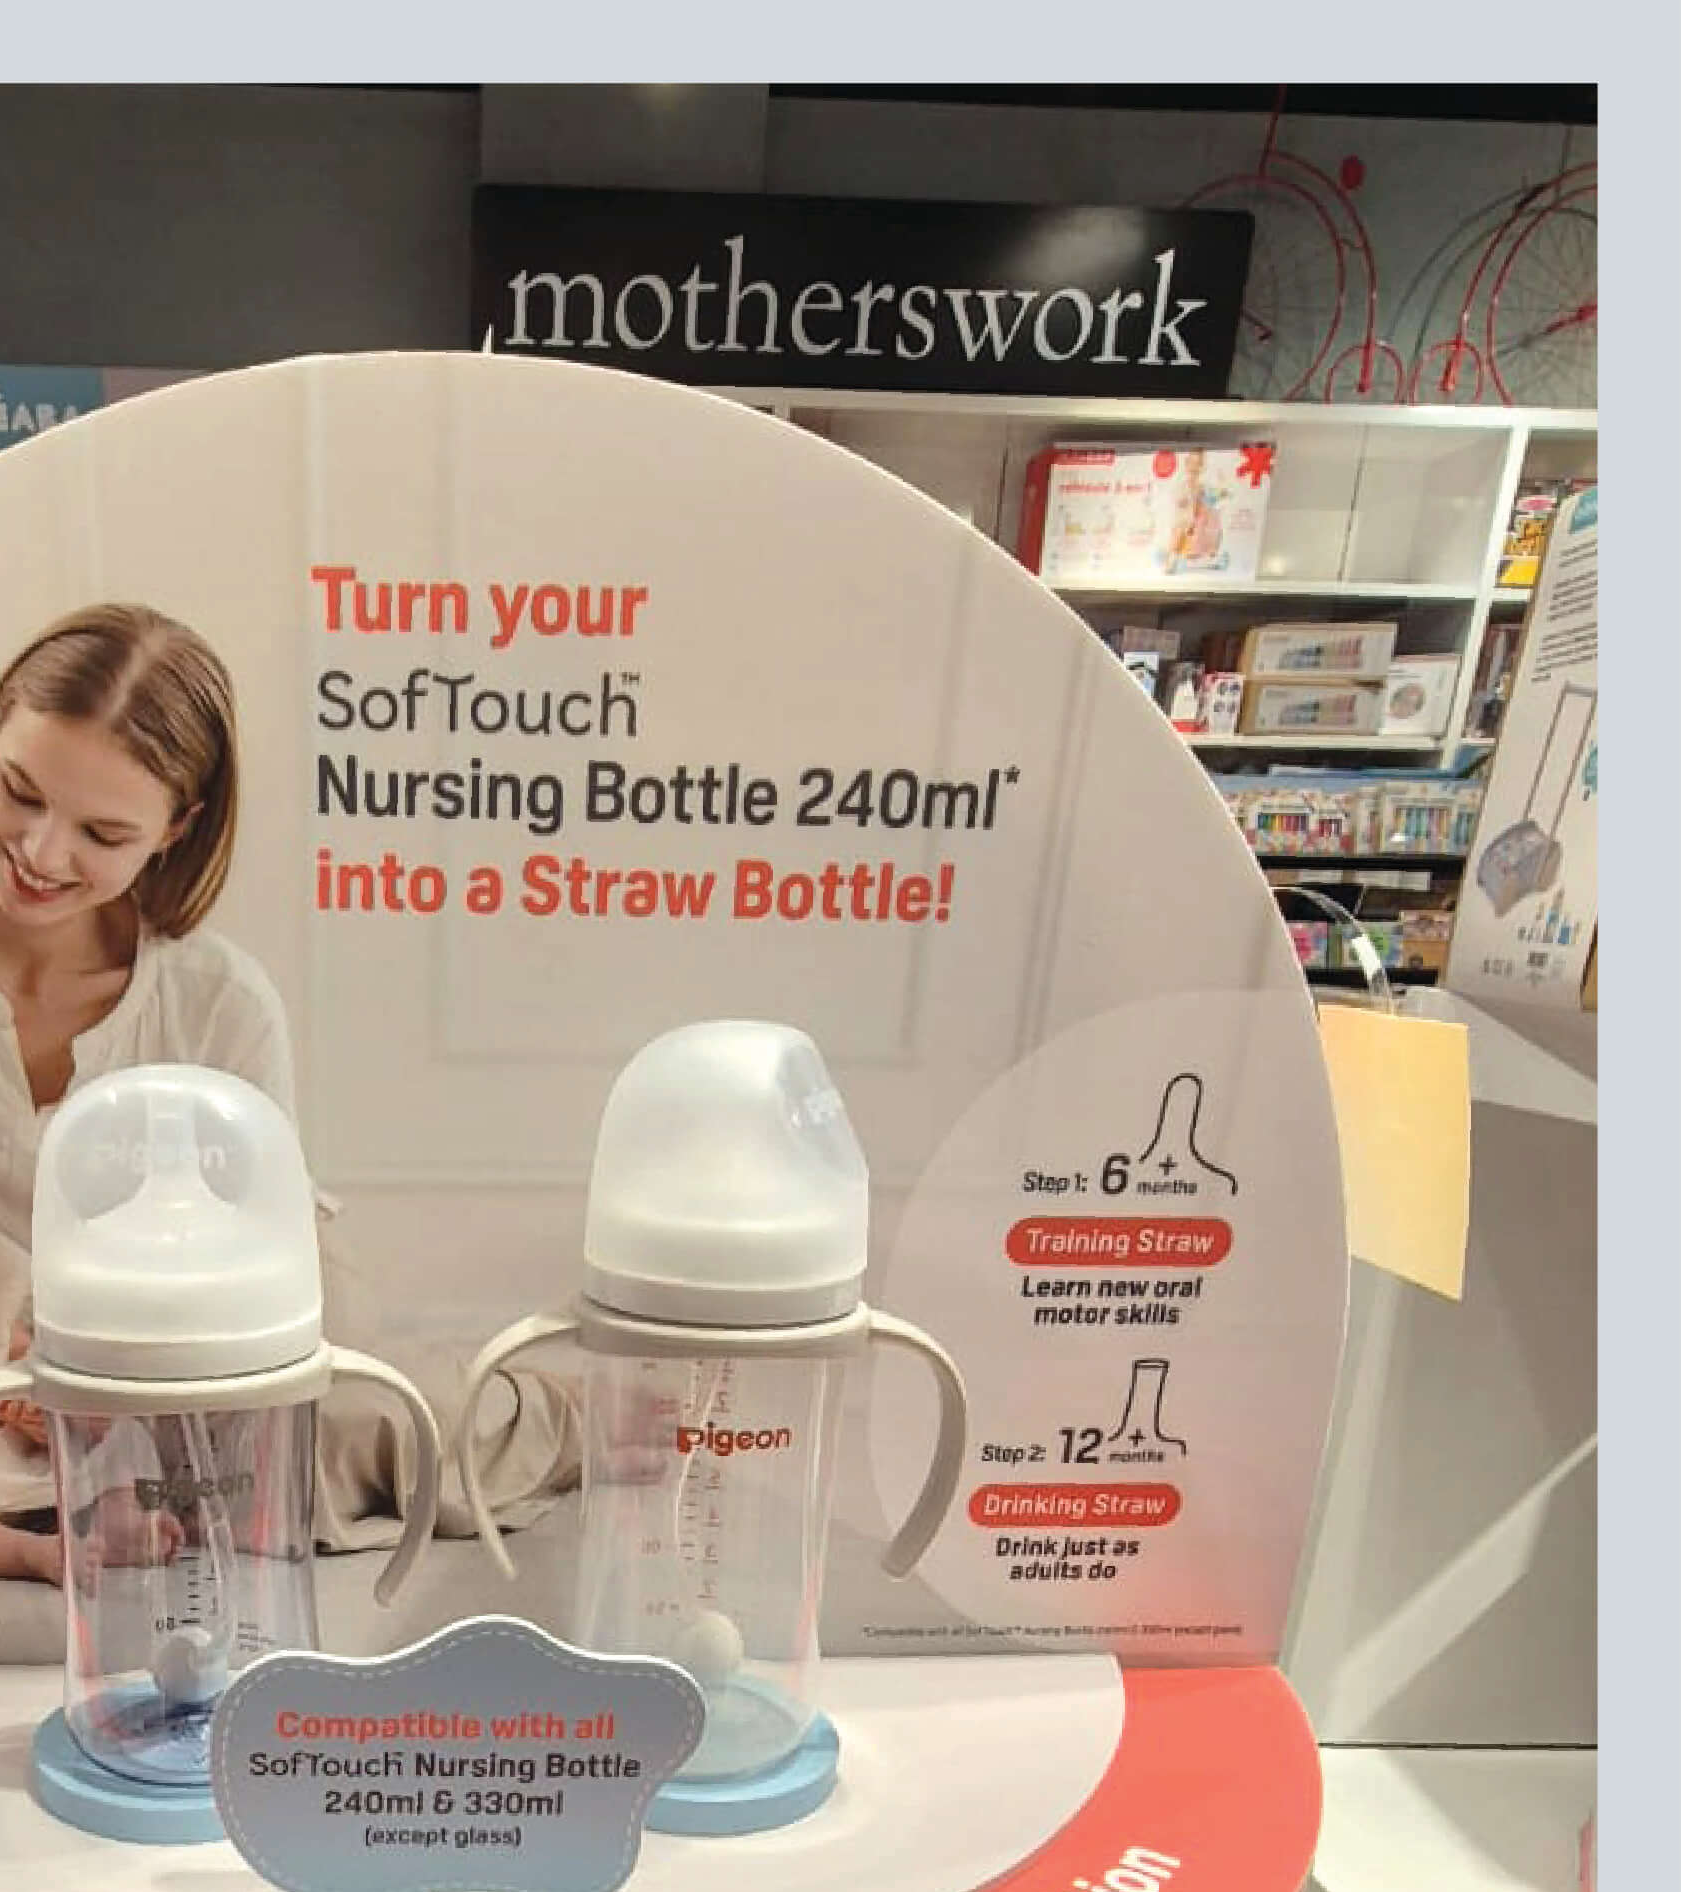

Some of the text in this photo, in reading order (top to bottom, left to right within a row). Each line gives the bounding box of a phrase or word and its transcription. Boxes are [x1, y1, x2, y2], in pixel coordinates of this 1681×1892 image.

[503, 233, 1209, 368] motherswork
[311, 566, 649, 650] Turn your
[317, 754, 565, 836] Nursing
[585, 759, 779, 827] Bottle
[315, 847, 957, 924] into a Straw Bottle!
[1021, 1171, 1069, 1198] Step
[1100, 1152, 1130, 1196] 6
[1136, 1178, 1199, 1197] months
[1025, 1226, 1216, 1258] Training Straw
[1021, 1275, 1204, 1299] Learn new oral
[1033, 1303, 1181, 1326] motor skills
[675, 1422, 793, 1460] pigeon
[980, 1444, 1026, 1467] Step
[1058, 1427, 1102, 1465] 12
[1107, 1447, 1167, 1465] months
[982, 1491, 1167, 1521] Drinking Straw
[995, 1536, 1141, 1563] Drink just as
[1008, 1560, 1117, 1583] adults do
[275, 1709, 616, 1745] Compatible with all
[414, 1752, 536, 1784] Nursing
[545, 1752, 642, 1779] Bottle
[324, 1789, 424, 1816] 240ml
[462, 1789, 565, 1817] 330ml
[364, 1824, 523, 1849] (except glass)
